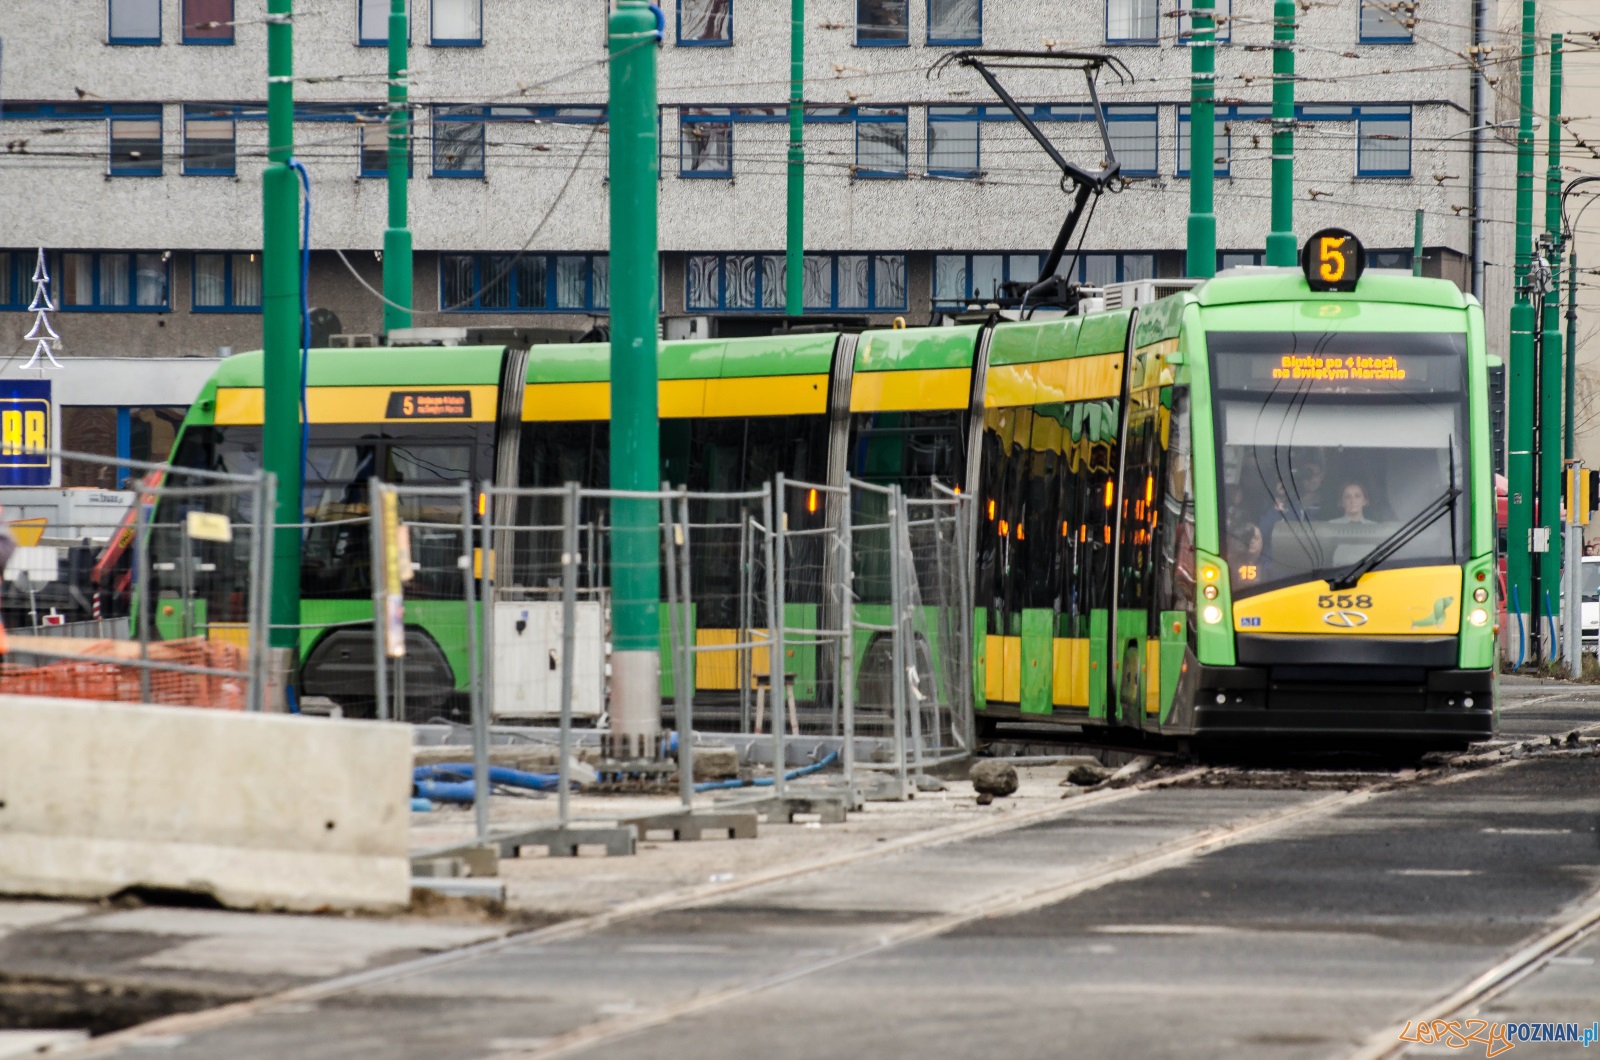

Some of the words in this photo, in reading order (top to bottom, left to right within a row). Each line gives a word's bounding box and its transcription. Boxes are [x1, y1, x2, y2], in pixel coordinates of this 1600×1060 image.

[1320, 236, 1345, 282] 5
[1281, 356, 1323, 368] Bimba
[1326, 358, 1343, 370] po
[1345, 356, 1354, 368] 4
[1356, 356, 1397, 368] latach
[1273, 368, 1290, 379] na
[403, 395, 414, 415] 5
[1239, 565, 1257, 579] 15
[1318, 594, 1373, 609] 558
